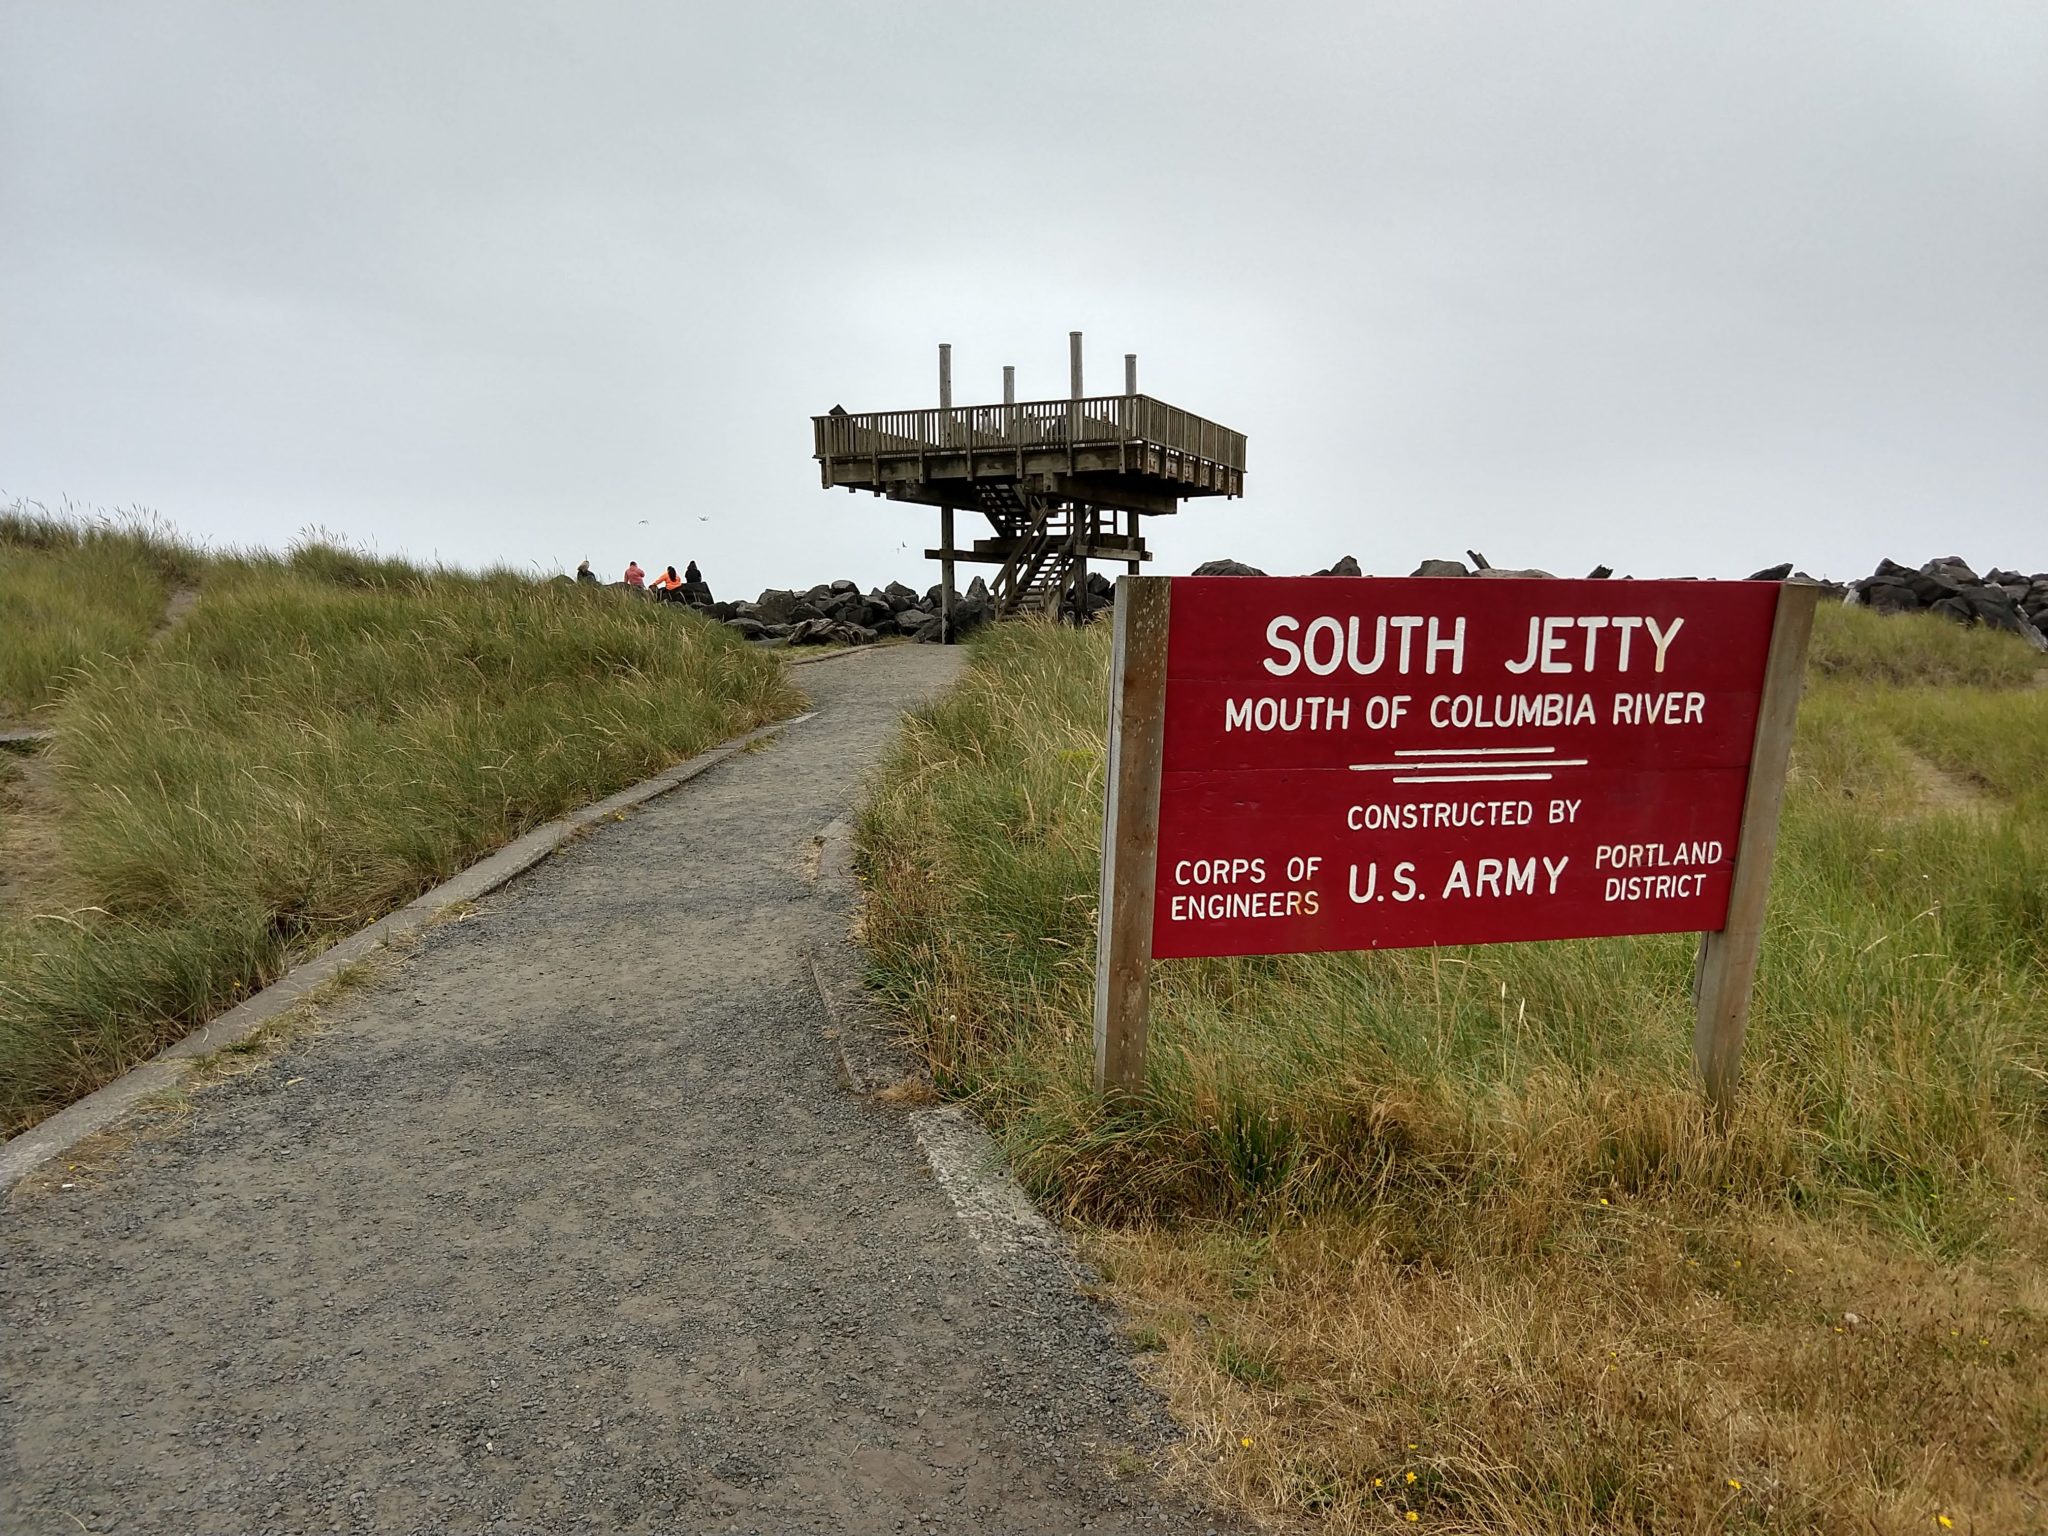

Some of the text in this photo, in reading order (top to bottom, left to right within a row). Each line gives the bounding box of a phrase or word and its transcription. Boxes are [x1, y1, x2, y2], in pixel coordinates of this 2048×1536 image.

[1263, 615, 1684, 676] SOUTH JETTY
[1226, 692, 1705, 732] MOUTH OF COLUMBIA RIVER
[1348, 799, 1581, 830] CONSTRUCTED BY
[1596, 841, 1722, 869] PORTLAND
[1176, 857, 1322, 885] CORPS OF
[1349, 856, 1569, 903] U.S. ARMY
[1605, 874, 1706, 901] DISTRICT
[1172, 891, 1319, 920] ENGINEERS
